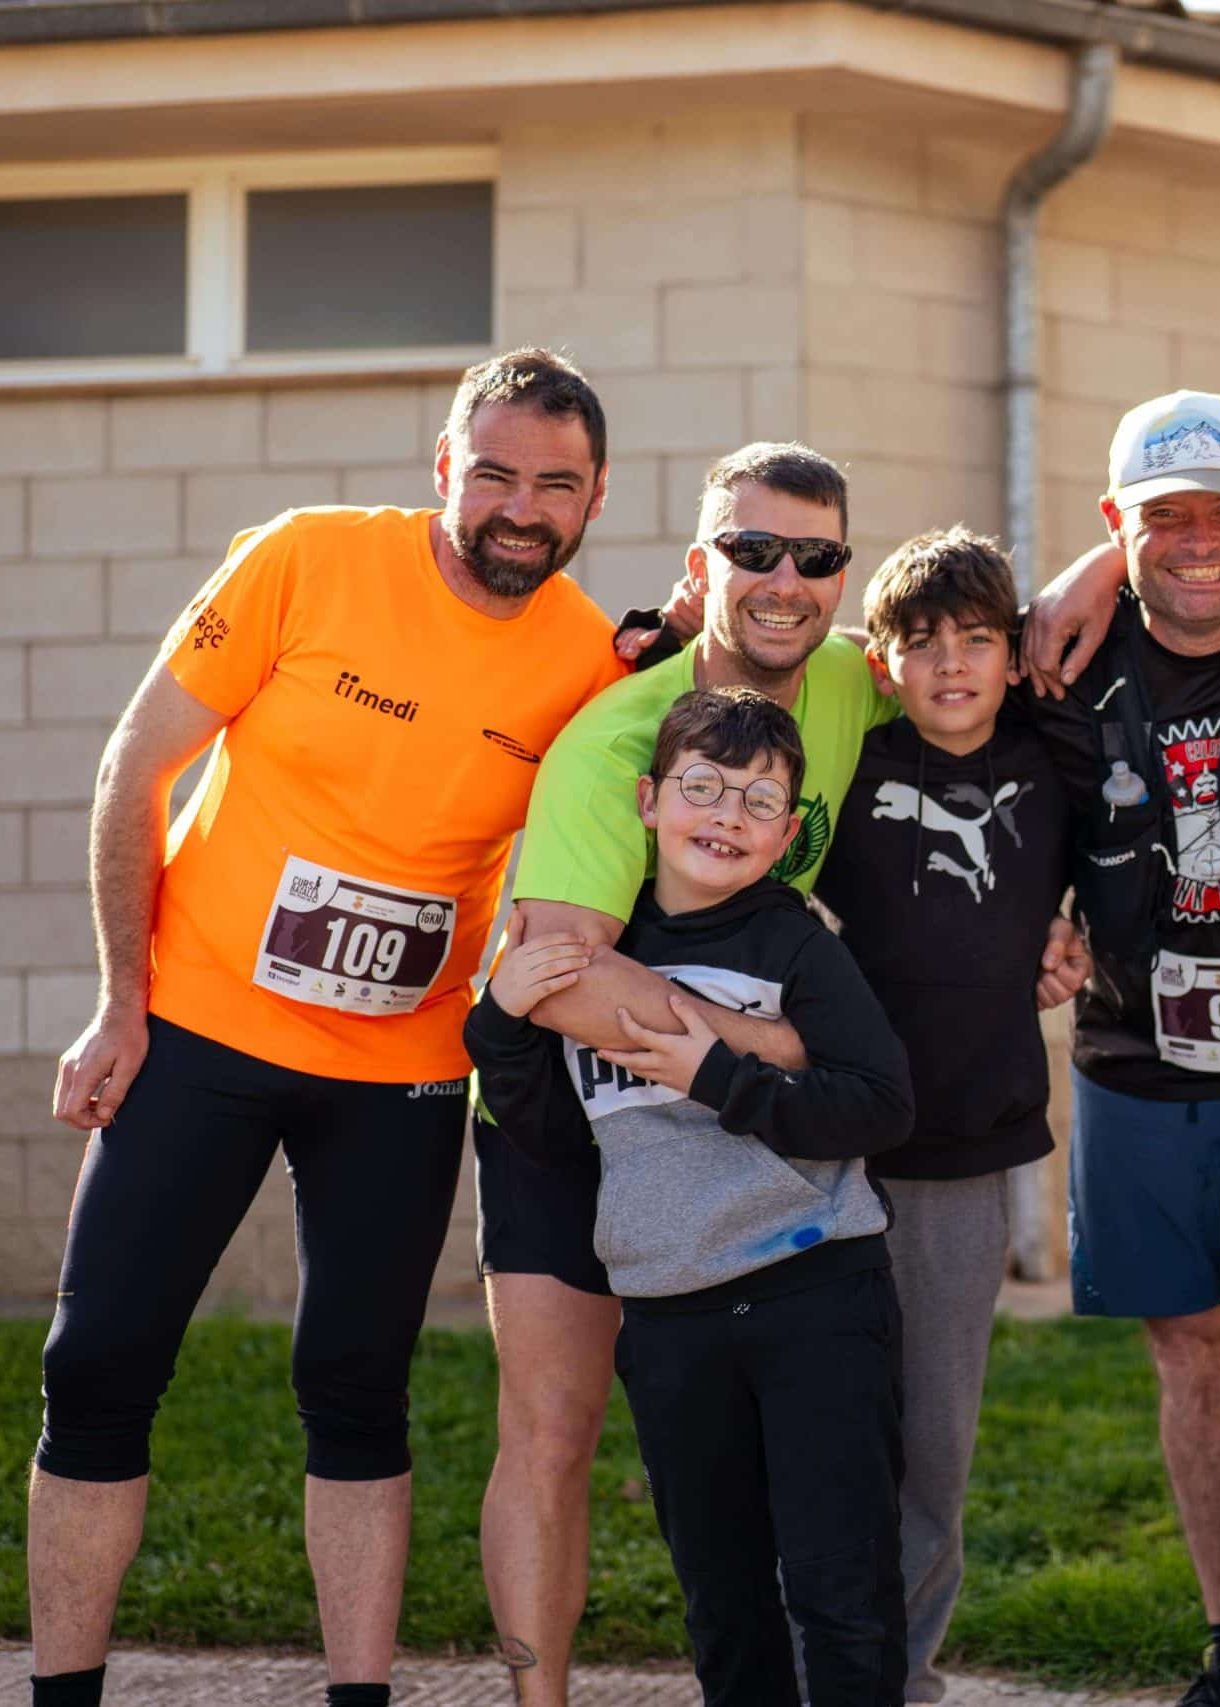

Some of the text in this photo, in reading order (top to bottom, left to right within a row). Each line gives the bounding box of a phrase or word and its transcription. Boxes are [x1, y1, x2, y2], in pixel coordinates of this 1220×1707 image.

[420, 911, 442, 926] 16KM
[321, 917, 407, 982] 109
[407, 1081, 464, 1098] Joma
